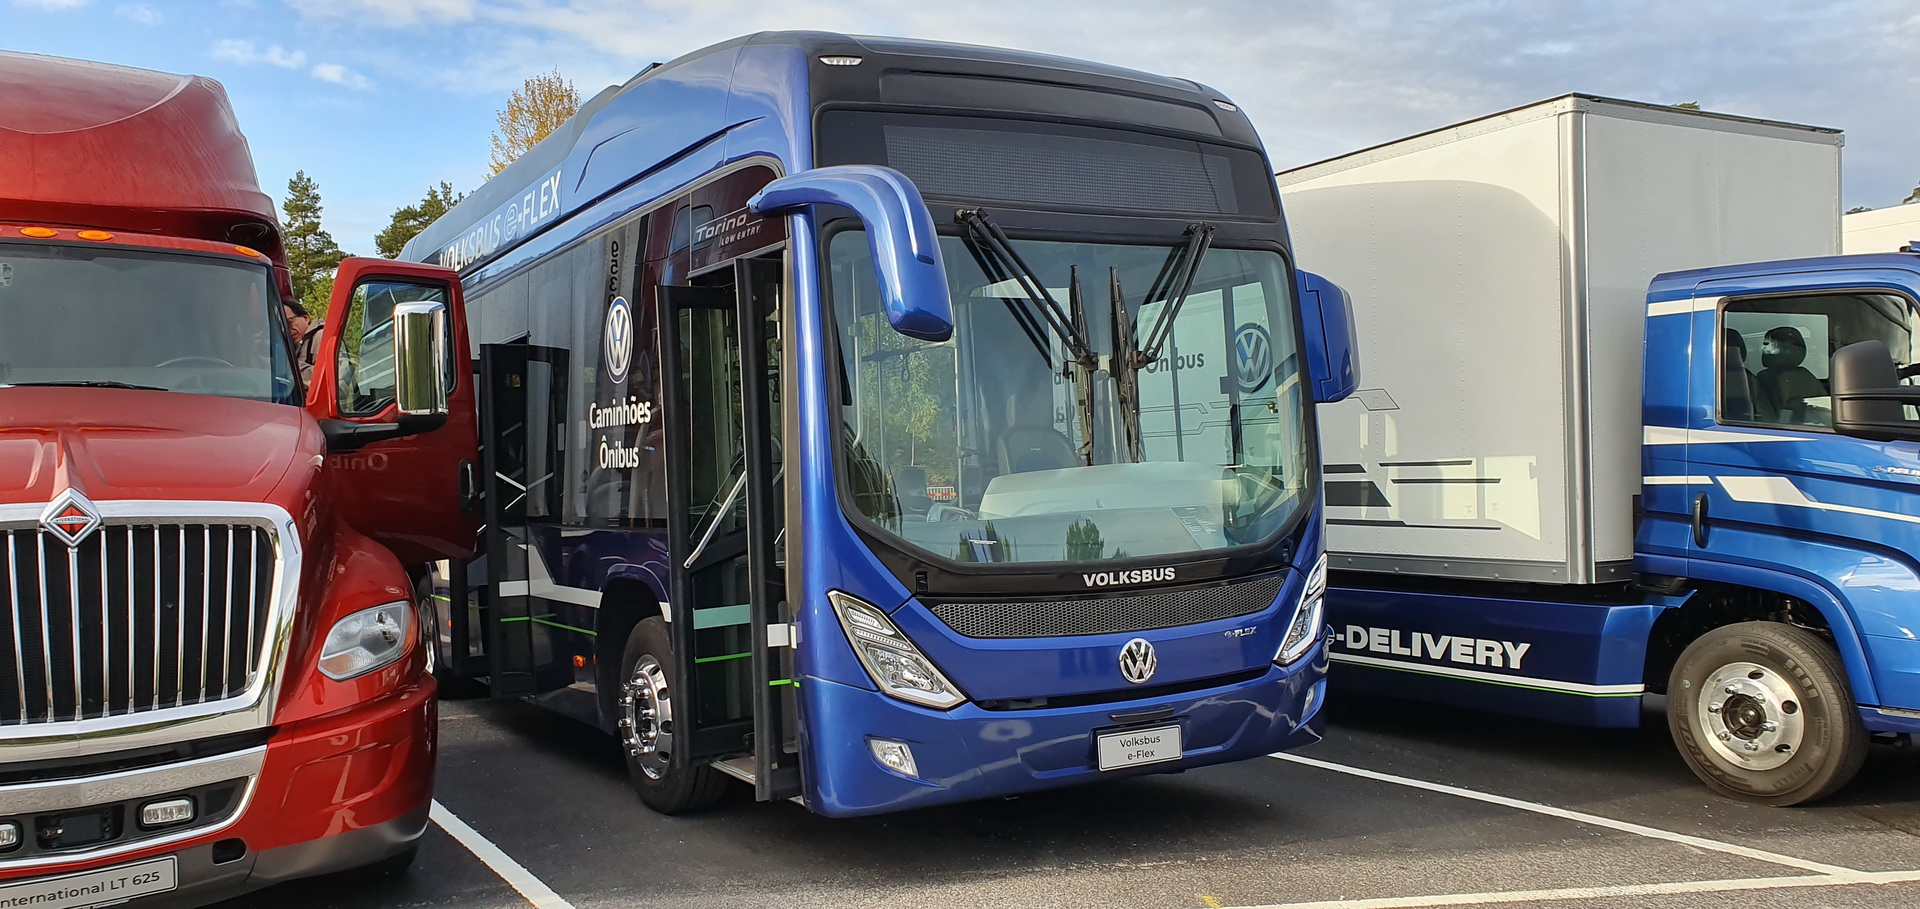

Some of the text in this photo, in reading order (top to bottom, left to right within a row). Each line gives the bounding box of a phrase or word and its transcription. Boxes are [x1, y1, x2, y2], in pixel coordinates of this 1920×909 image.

[440, 170, 562, 272] VOLKSBUS e-FLEX
[696, 214, 747, 242] Torino
[721, 224, 761, 246] LOW ENTRY
[589, 396, 651, 429] Caminhões
[600, 435, 640, 470] Ônibus
[1083, 567, 1176, 587] VOLKSBUS
[1120, 735, 1161, 748] Volksbus
[1127, 749, 1155, 760] e-Flex
[0, 871, 160, 909] nternational LT 625
